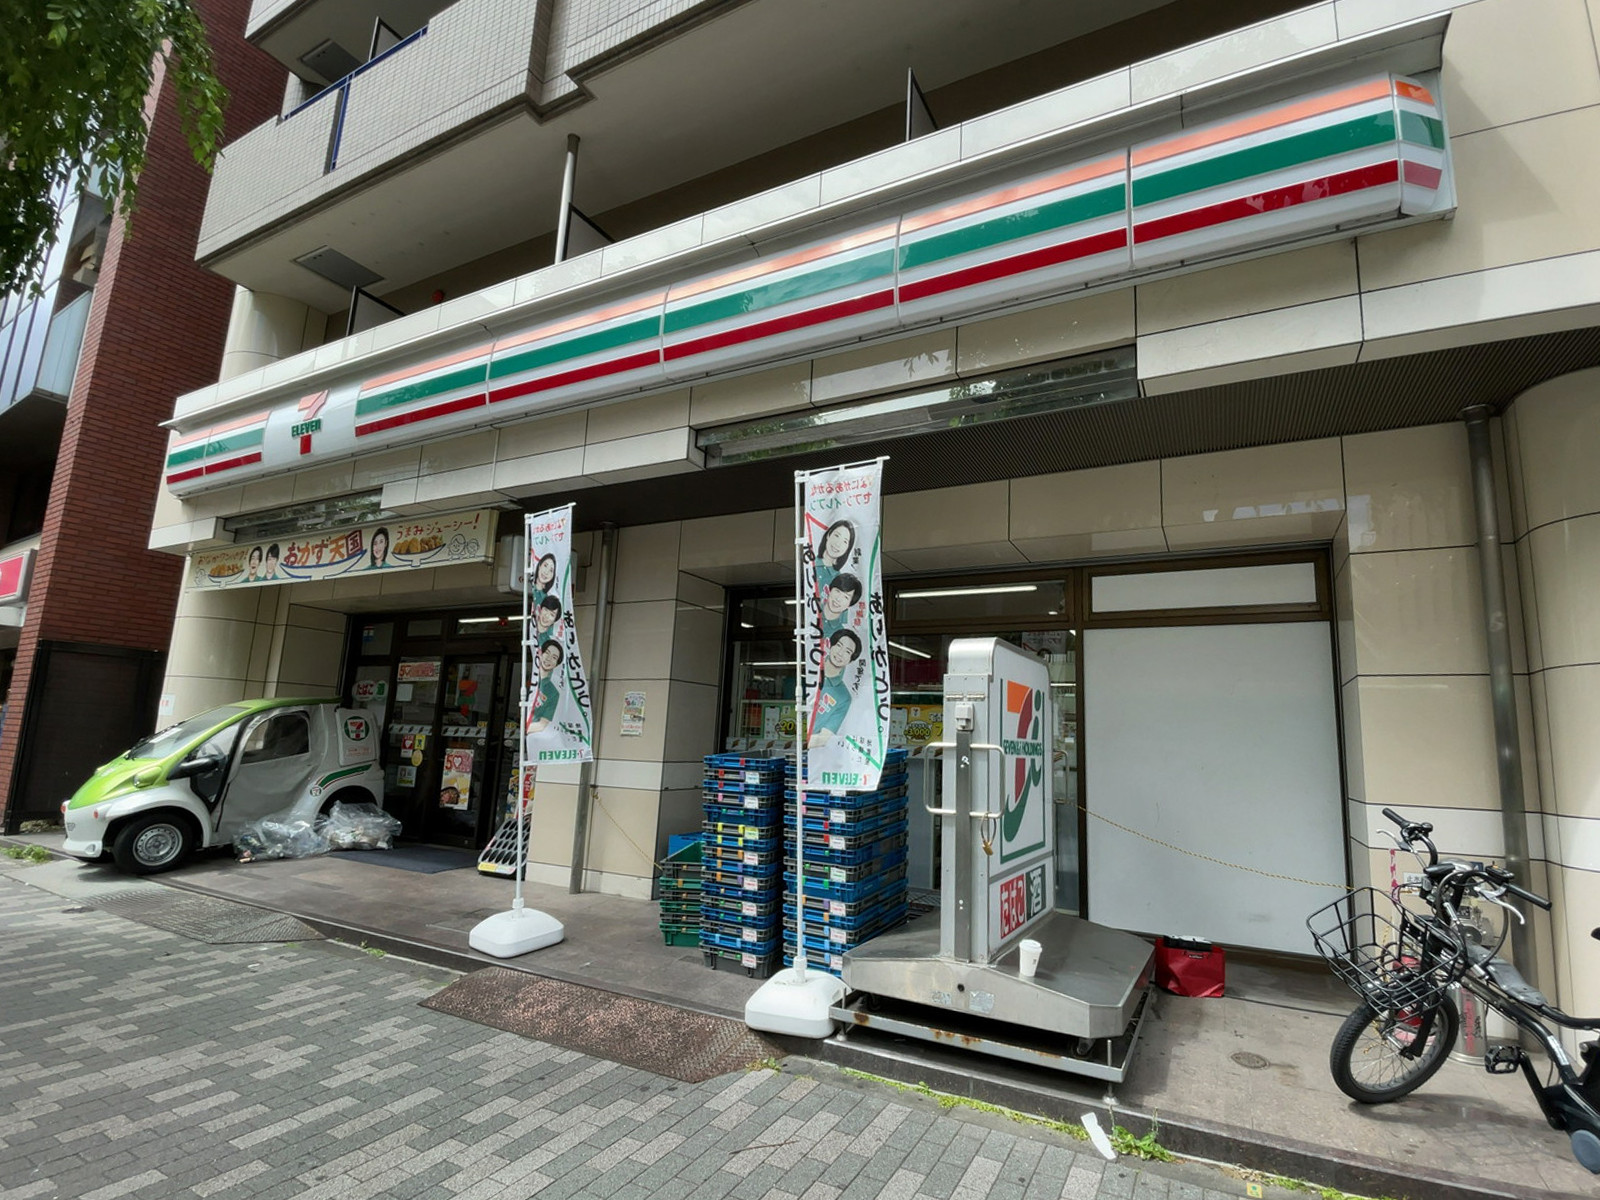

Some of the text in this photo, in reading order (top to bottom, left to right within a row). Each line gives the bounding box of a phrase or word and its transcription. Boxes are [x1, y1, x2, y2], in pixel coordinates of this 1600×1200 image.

[284, 529, 364, 566] おかず天国
[1001, 877, 1025, 937] たばこ
[1030, 865, 1043, 916] 酒
